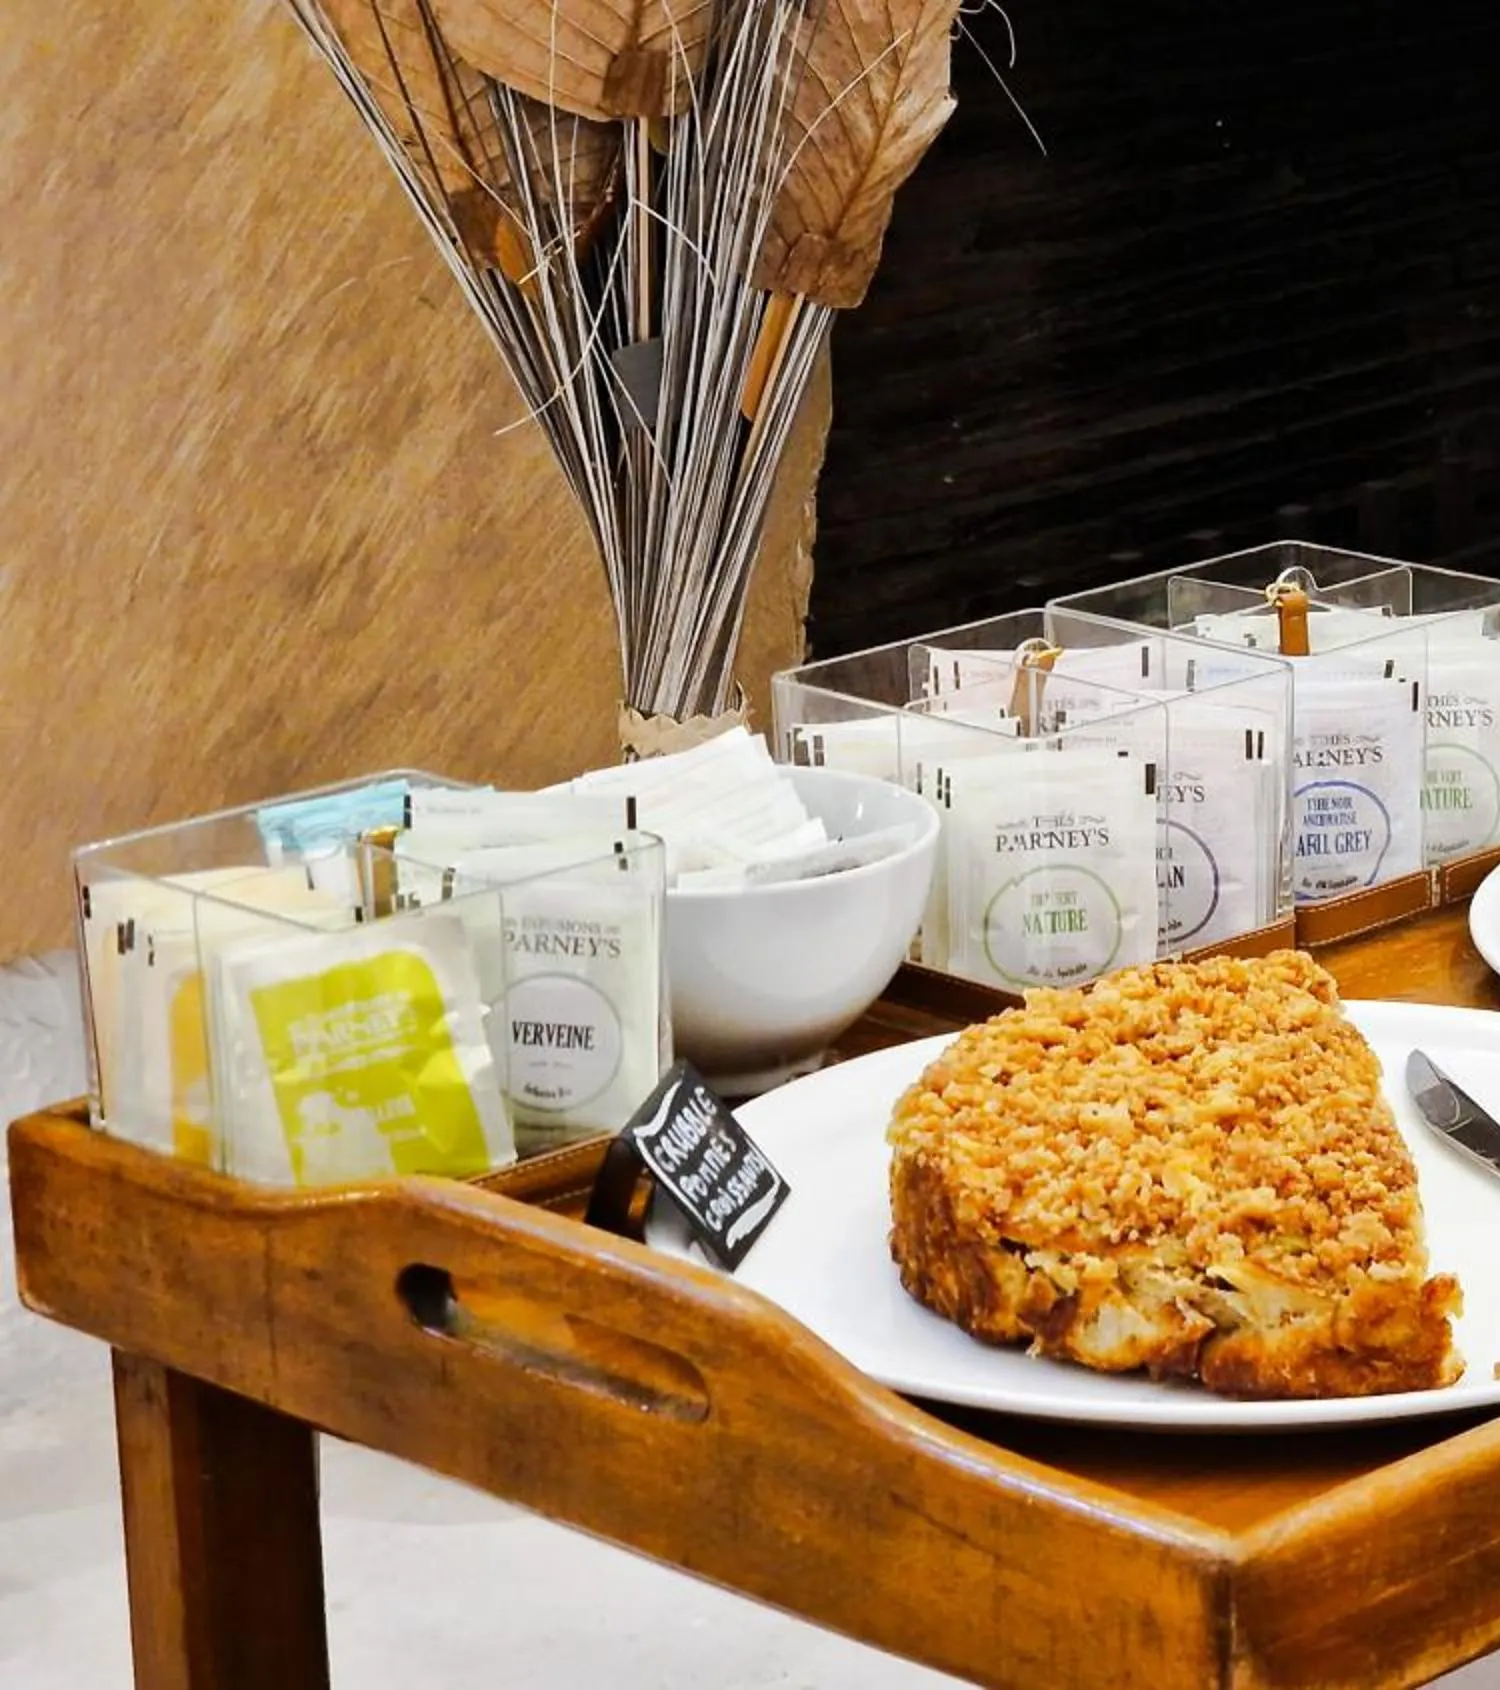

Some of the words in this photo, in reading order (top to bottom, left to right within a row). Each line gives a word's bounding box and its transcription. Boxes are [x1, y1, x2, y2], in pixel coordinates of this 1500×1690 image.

[996, 827, 1110, 853] PARNEY'S
[1335, 829, 1373, 854] GREY
[512, 1019, 596, 1051] VERVEINE
